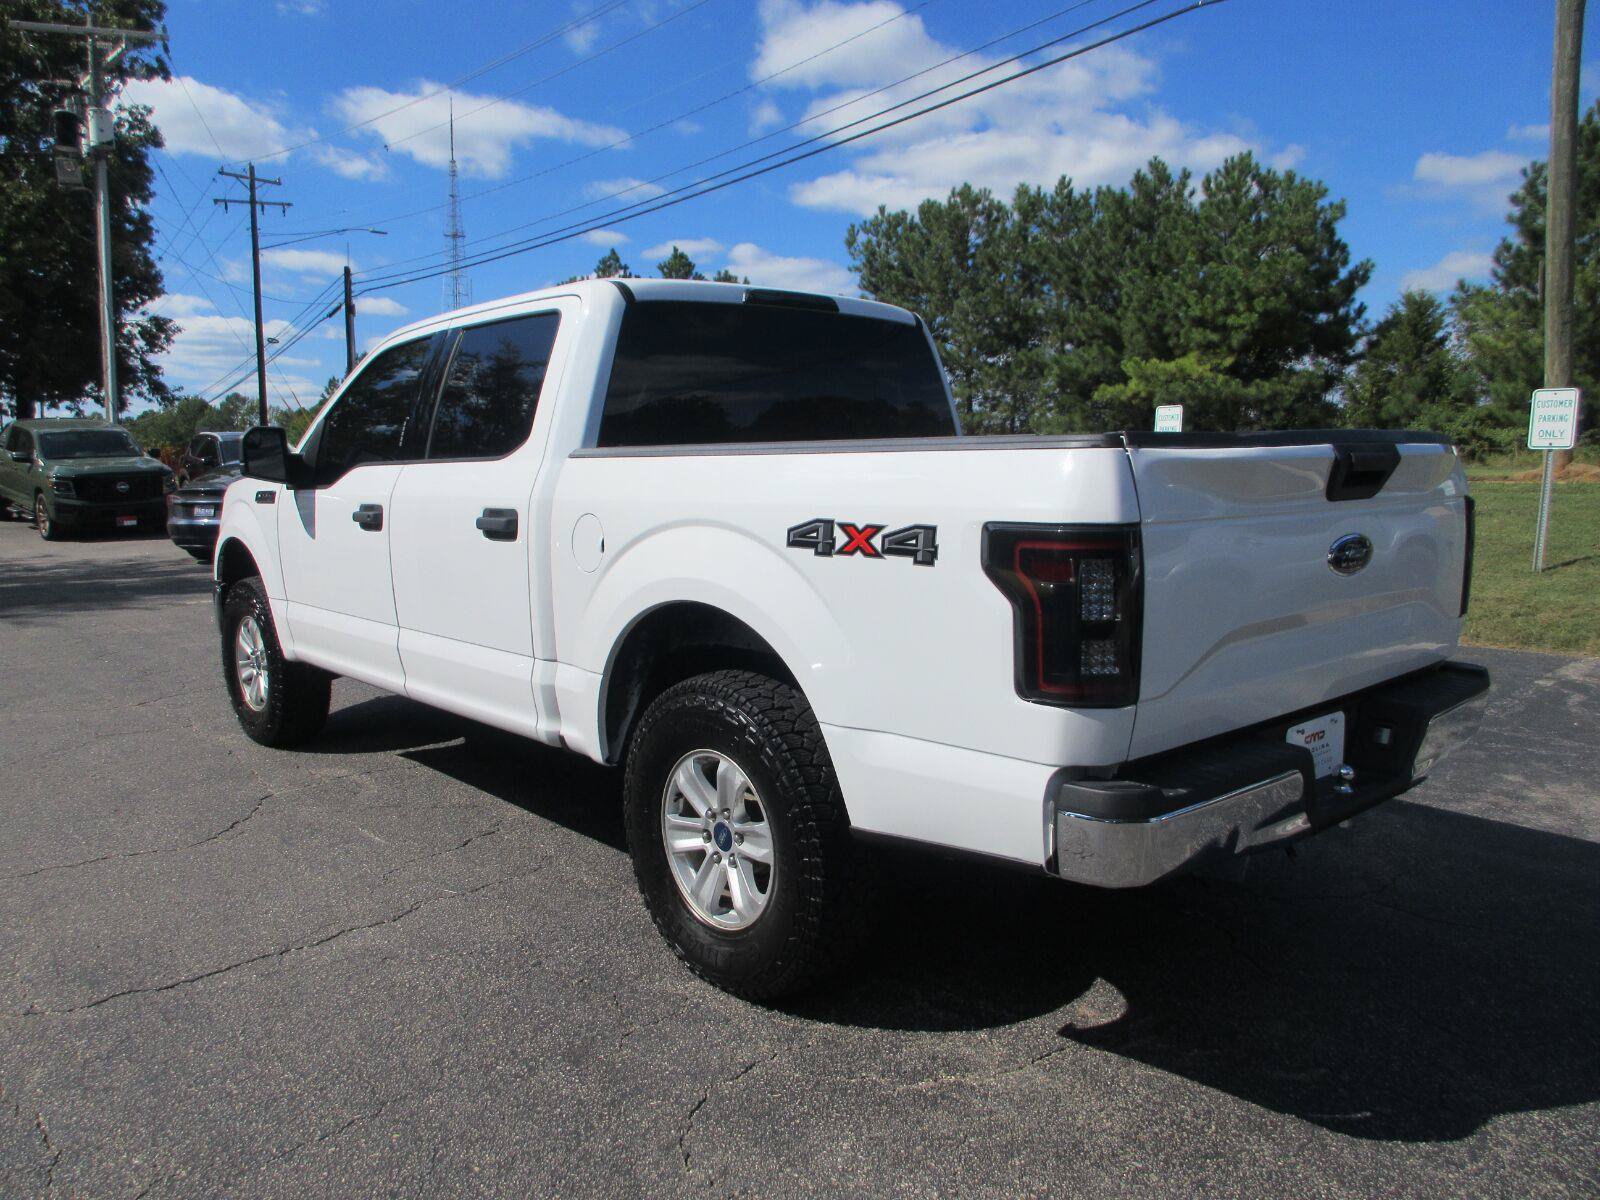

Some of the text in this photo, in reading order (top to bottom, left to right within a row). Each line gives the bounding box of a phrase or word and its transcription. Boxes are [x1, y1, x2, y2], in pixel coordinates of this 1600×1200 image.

[1536, 399, 1573, 408] CUSTOMER
[1537, 413, 1569, 422] PARKING
[1538, 429, 1566, 438] ONLY
[786, 518, 938, 567] 4X4
